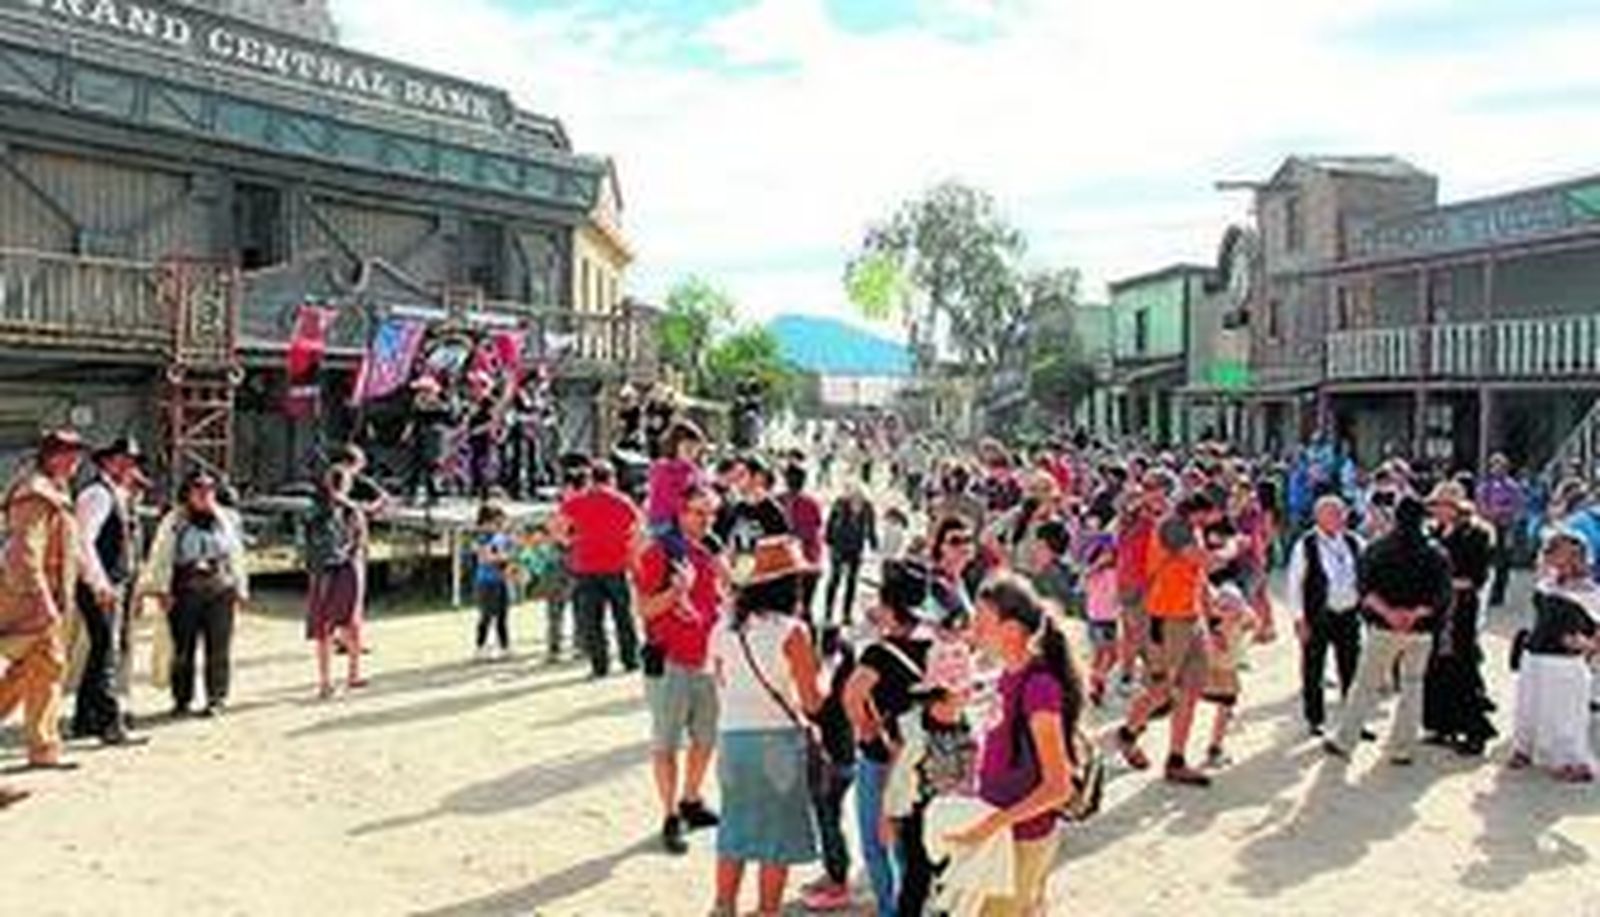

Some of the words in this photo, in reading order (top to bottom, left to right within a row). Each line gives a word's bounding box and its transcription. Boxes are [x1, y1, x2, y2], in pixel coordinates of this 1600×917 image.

[26, 0, 191, 44] RAND
[208, 27, 393, 96] CENTRAL
[405, 80, 493, 120] BANK
